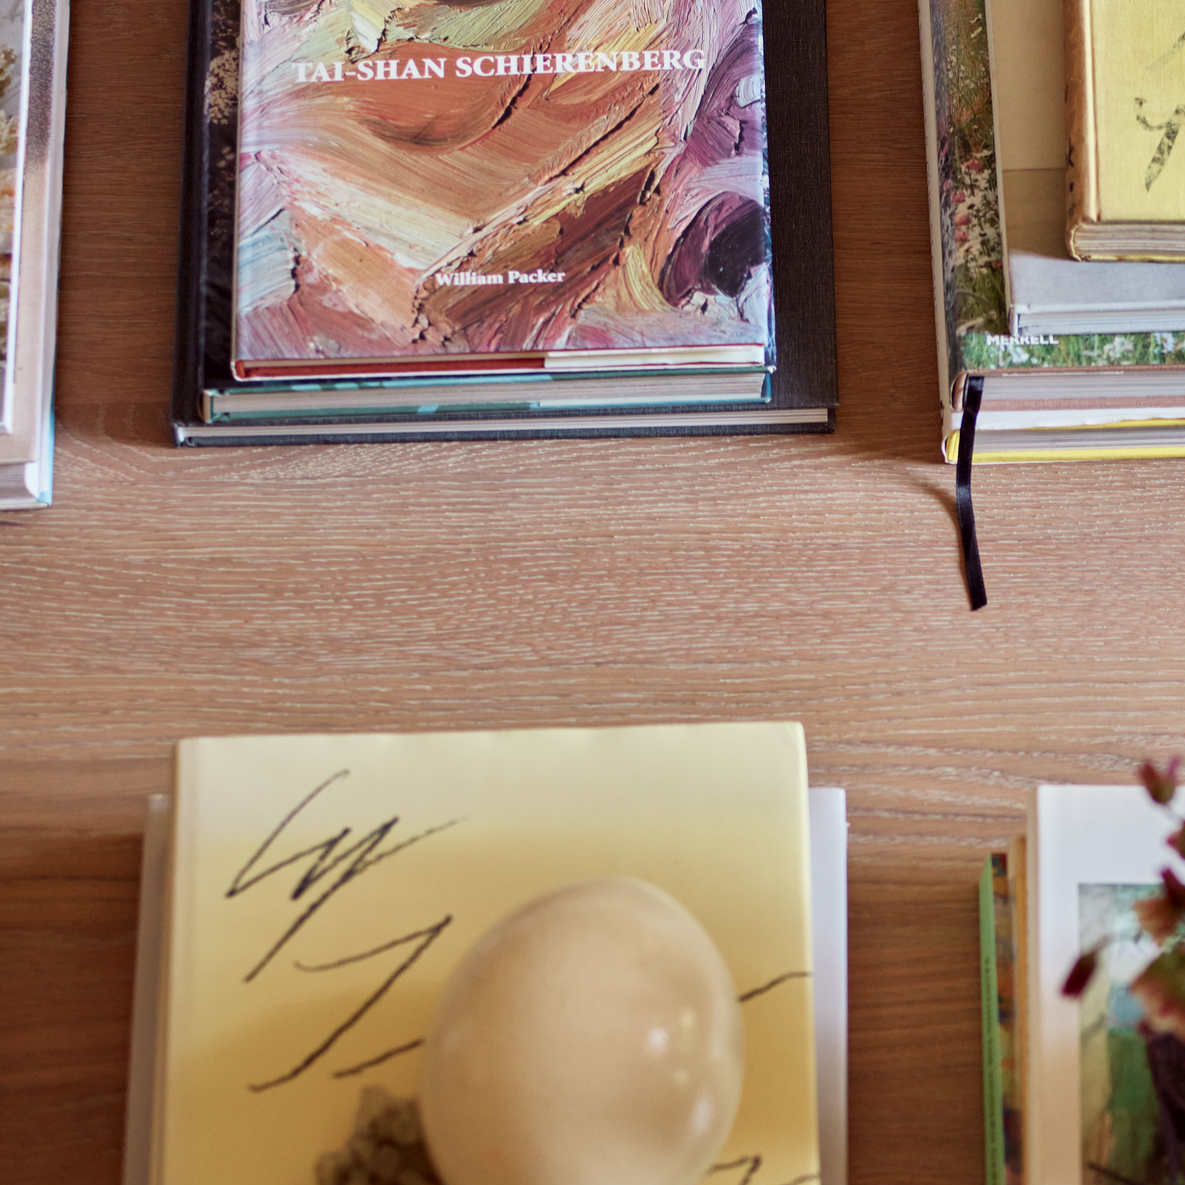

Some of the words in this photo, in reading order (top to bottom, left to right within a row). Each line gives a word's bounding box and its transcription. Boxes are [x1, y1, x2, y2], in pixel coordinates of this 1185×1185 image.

[291, 57, 447, 84] TAI-SHAN
[455, 48, 707, 78] SCHIERENBERG
[435, 271, 504, 286] William
[508, 269, 566, 284] Packer
[986, 334, 1060, 346] MERRELL
